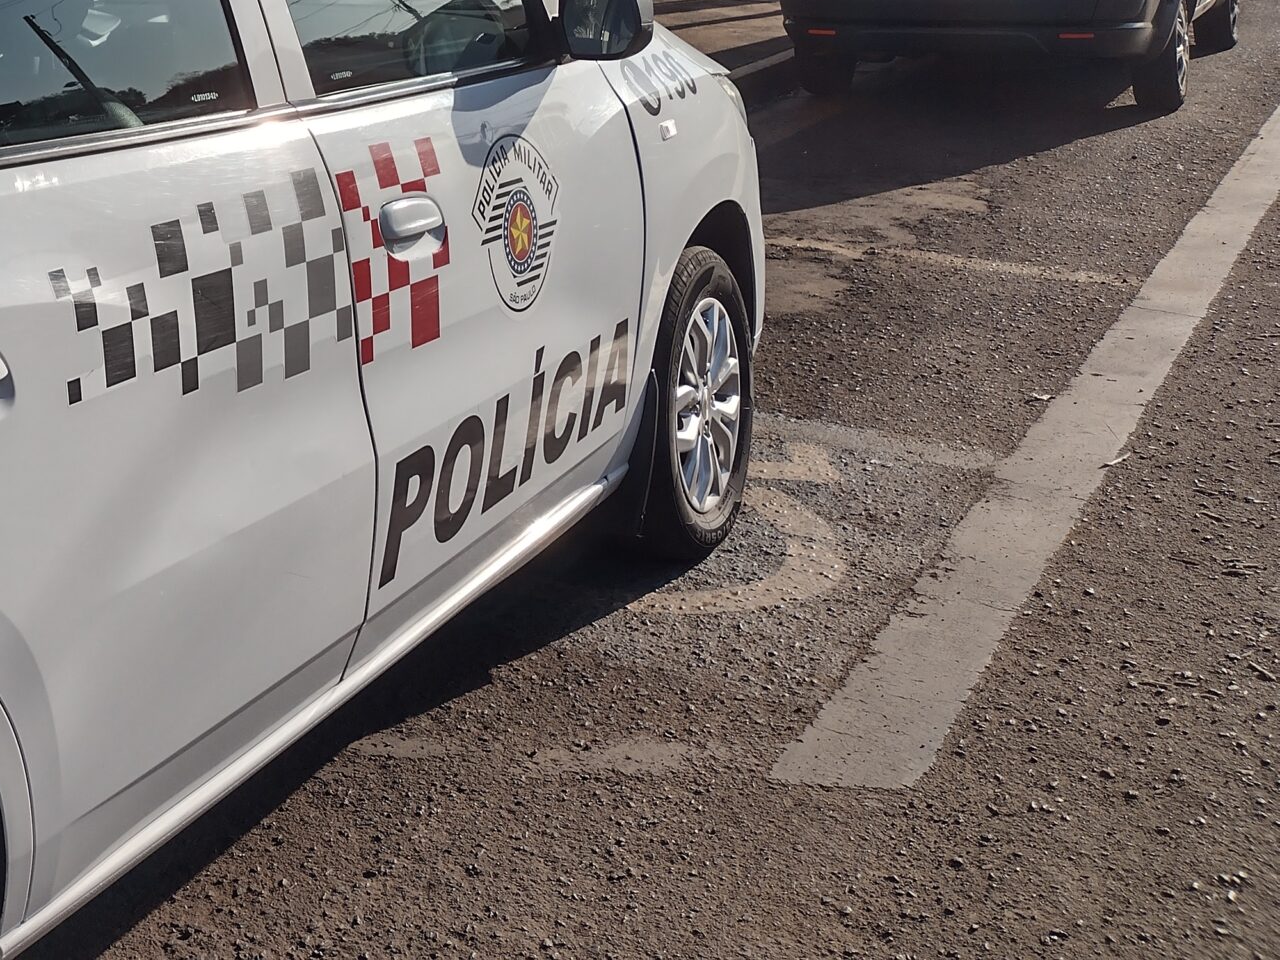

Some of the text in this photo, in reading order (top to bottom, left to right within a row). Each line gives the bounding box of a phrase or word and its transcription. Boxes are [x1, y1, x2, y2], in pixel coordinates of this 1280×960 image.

[512, 141, 553, 200] MILITAR
[509, 284, 536, 304] SÃO PAULO
[379, 317, 629, 590] POLÍCIA
